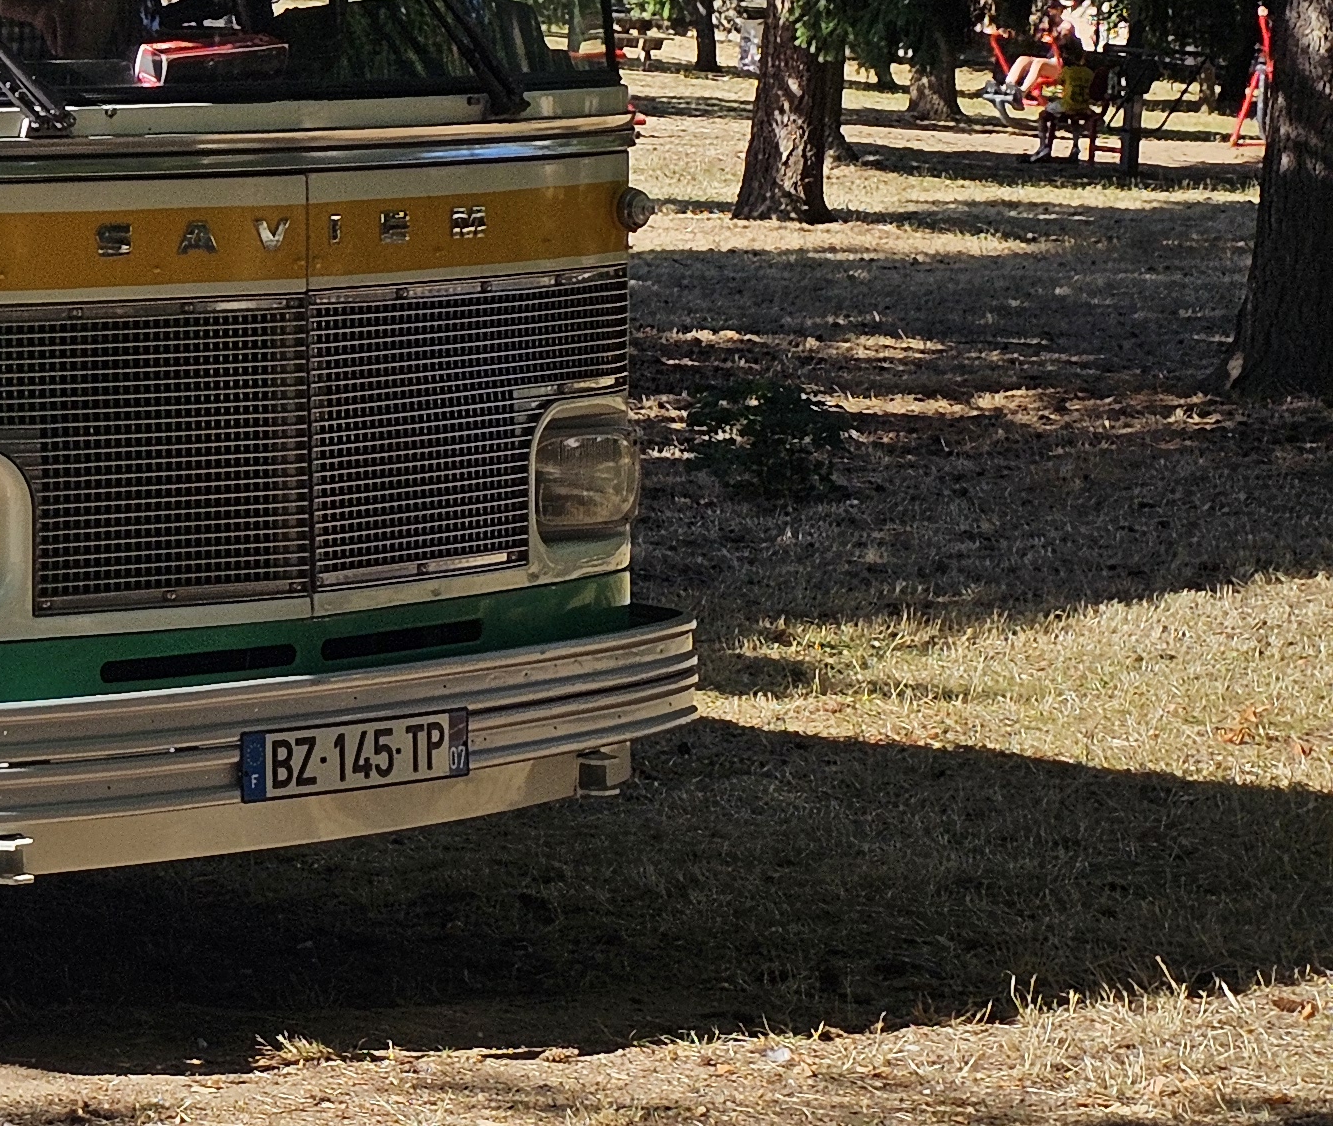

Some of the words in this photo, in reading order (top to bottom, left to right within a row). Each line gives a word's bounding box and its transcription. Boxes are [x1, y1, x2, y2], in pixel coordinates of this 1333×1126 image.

[95, 205, 488, 258] SAVIEM
[251, 774, 259, 788] F
[449, 745, 466, 770] 07
